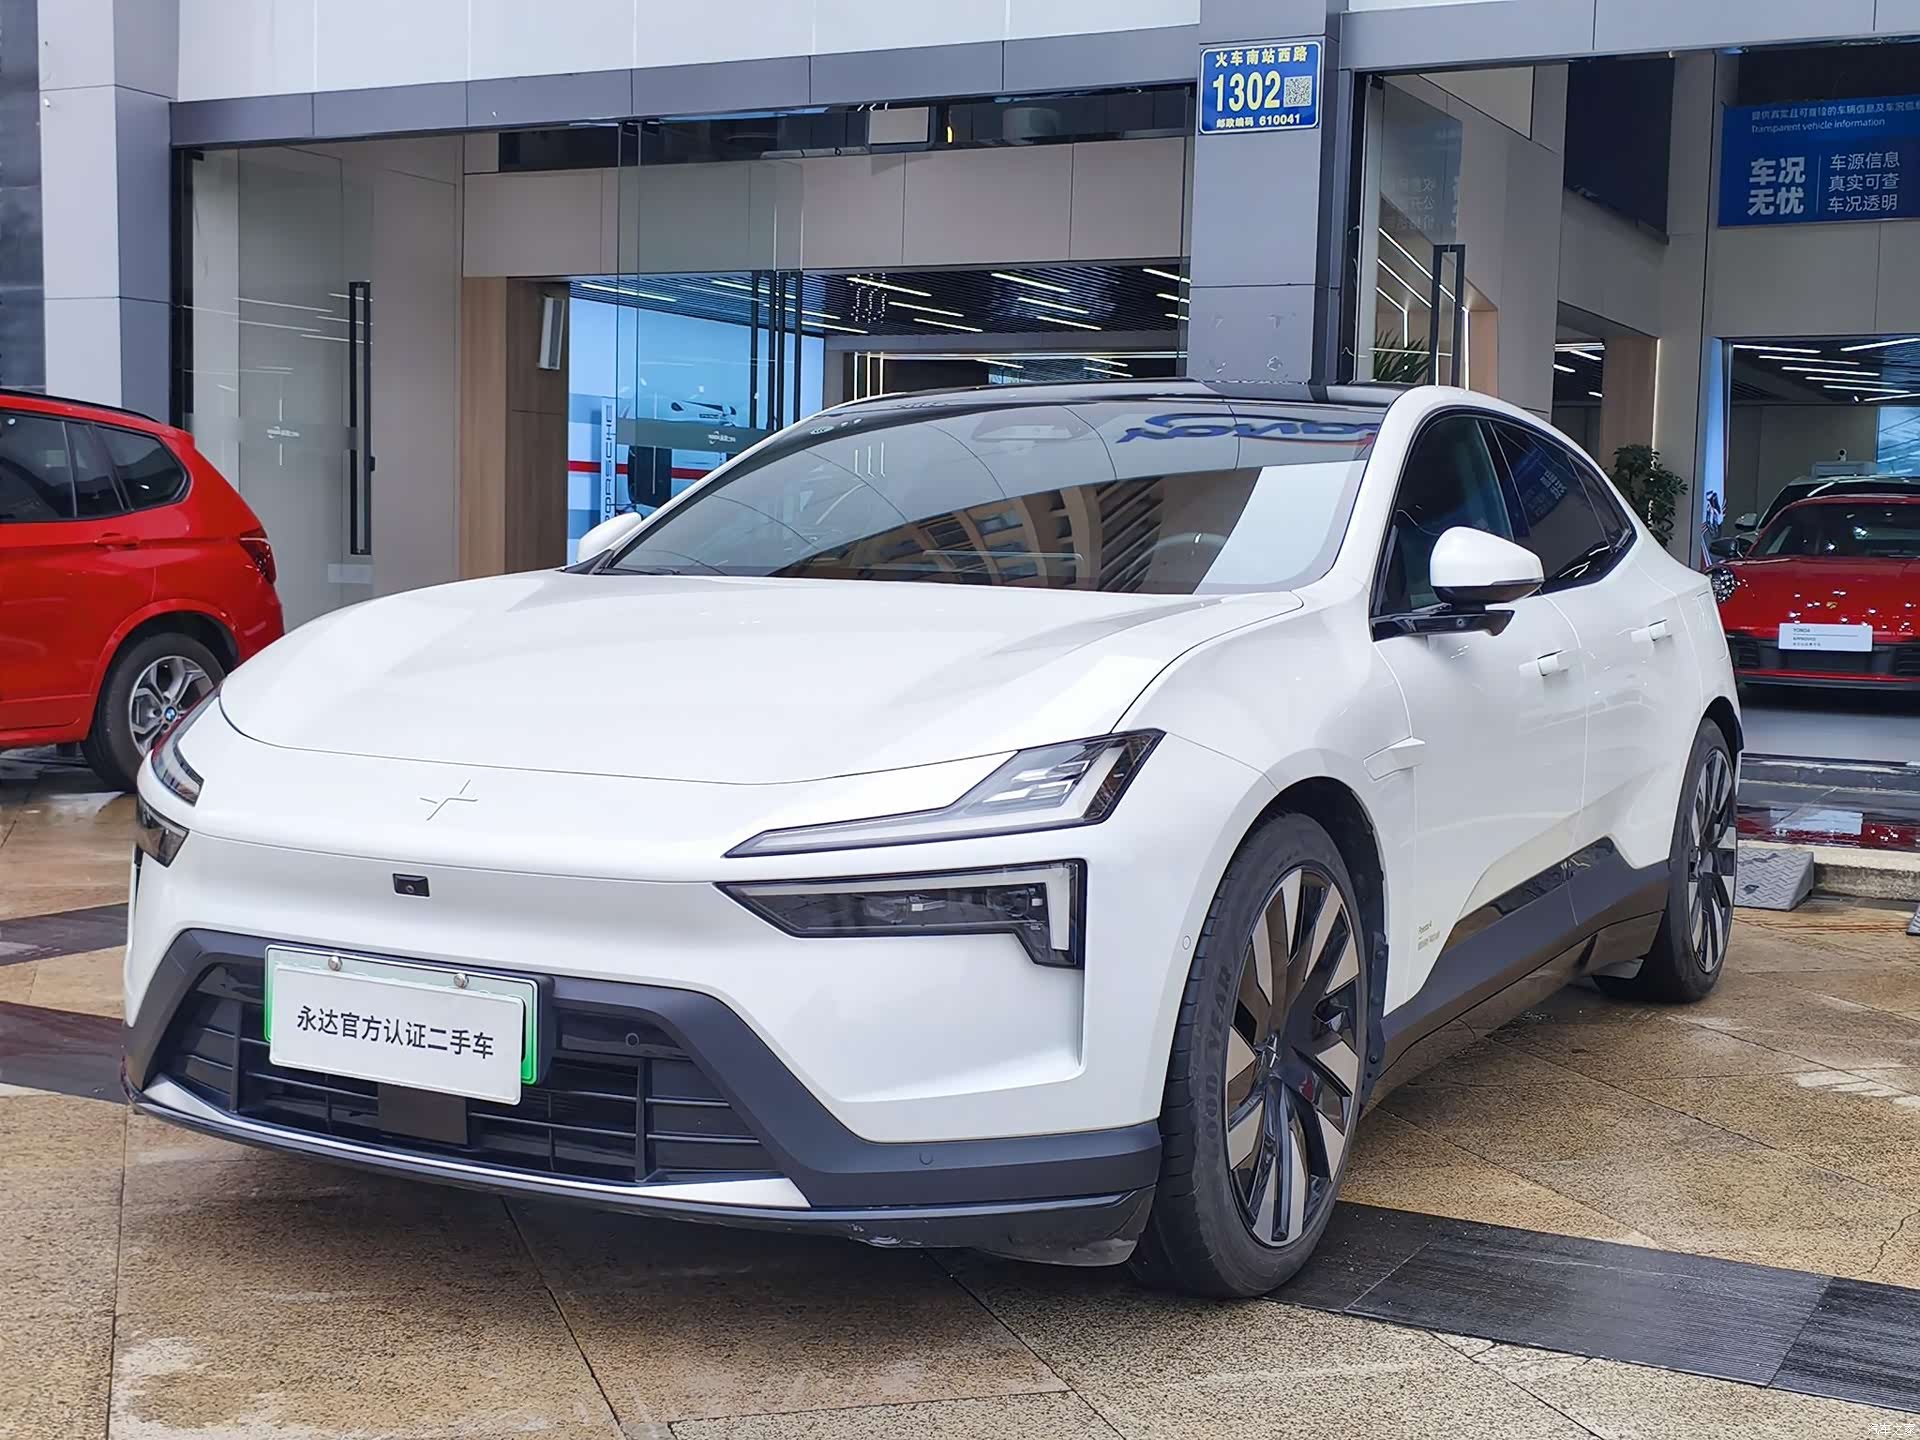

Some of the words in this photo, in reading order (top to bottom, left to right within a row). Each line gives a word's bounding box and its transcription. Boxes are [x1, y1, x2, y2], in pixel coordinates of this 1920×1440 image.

[1215, 46, 1307, 68] 火车南站西路
[1212, 71, 1281, 112] 1302
[1216, 116, 1254, 128] 邮政编码
[1259, 113, 1300, 126] 610041
[1752, 123, 1801, 134] Transparent
[1802, 120, 1833, 131] vehicle
[1834, 118, 1886, 128] information
[1749, 157, 1806, 185] 车况
[1829, 151, 1900, 171] 车源信息
[1828, 173, 1900, 193] 真实可查
[1747, 187, 1805, 216] 无忧
[1827, 194, 1898, 214] 车况透明
[296, 1005, 495, 1060] 永达官方认证二手车
